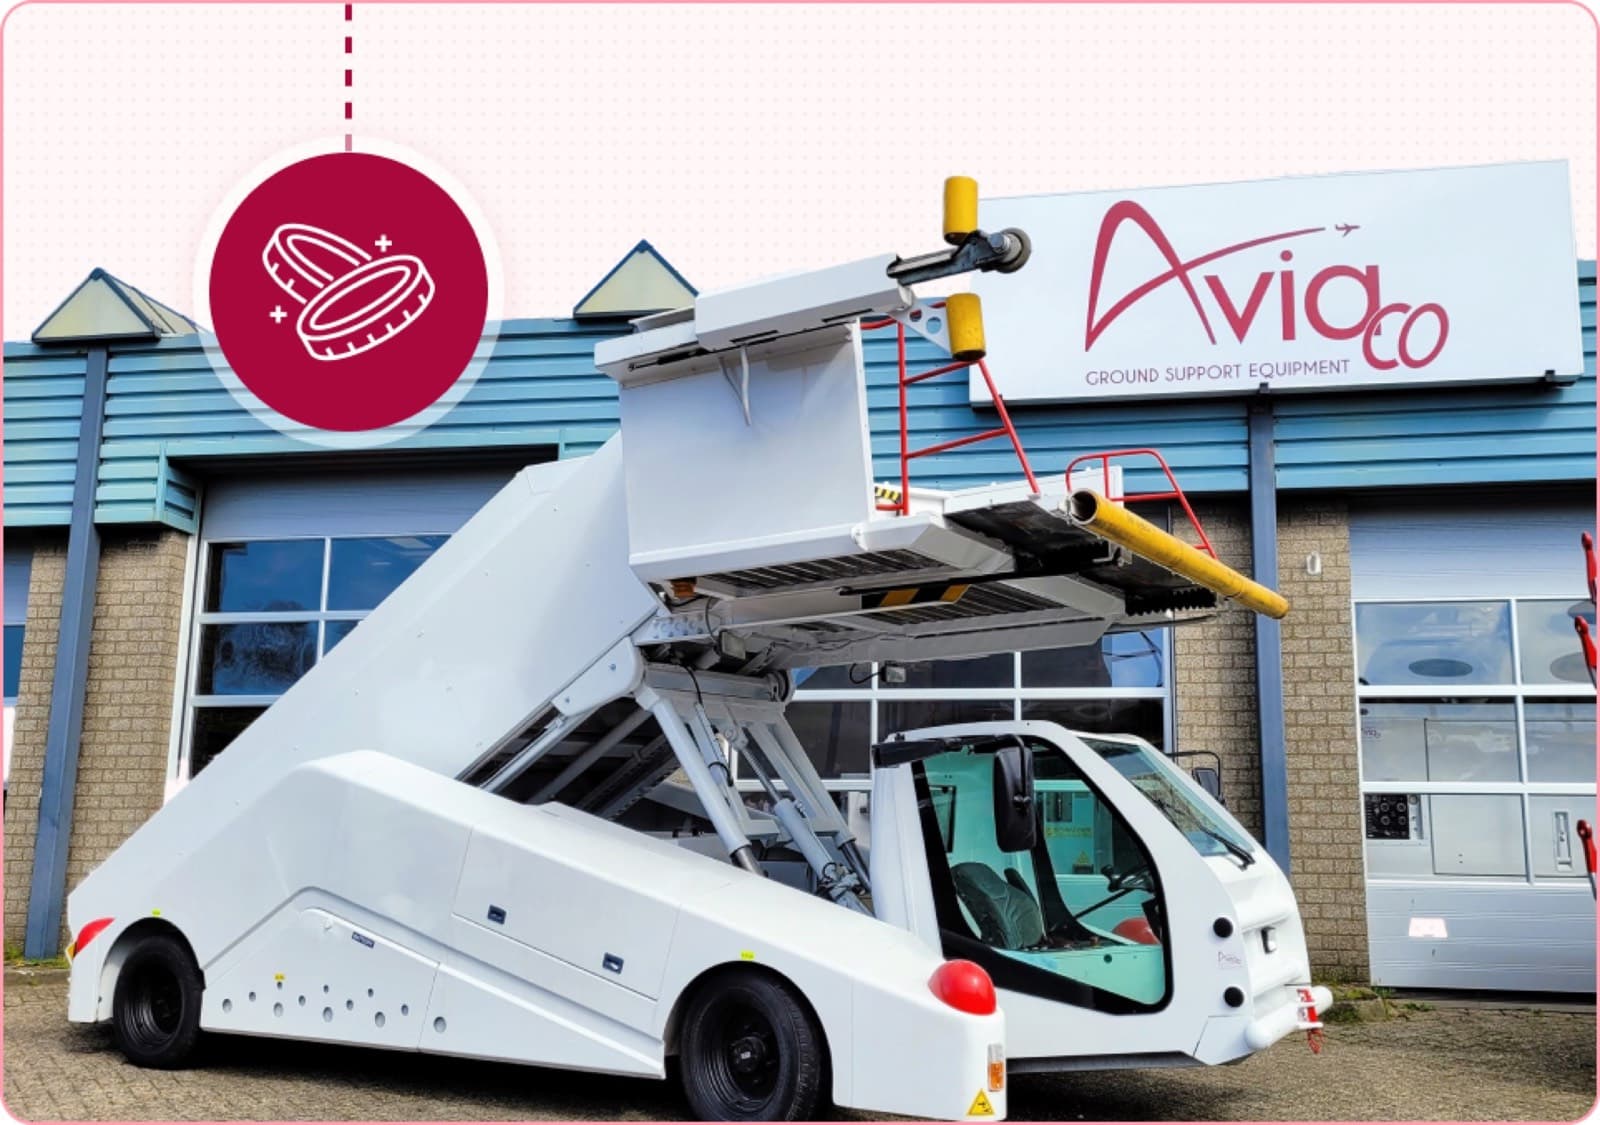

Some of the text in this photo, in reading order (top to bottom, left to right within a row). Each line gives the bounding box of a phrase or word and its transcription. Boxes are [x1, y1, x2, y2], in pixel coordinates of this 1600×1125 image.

[1085, 359, 1351, 386] GROUND SUPPORT EQUIPMENT
